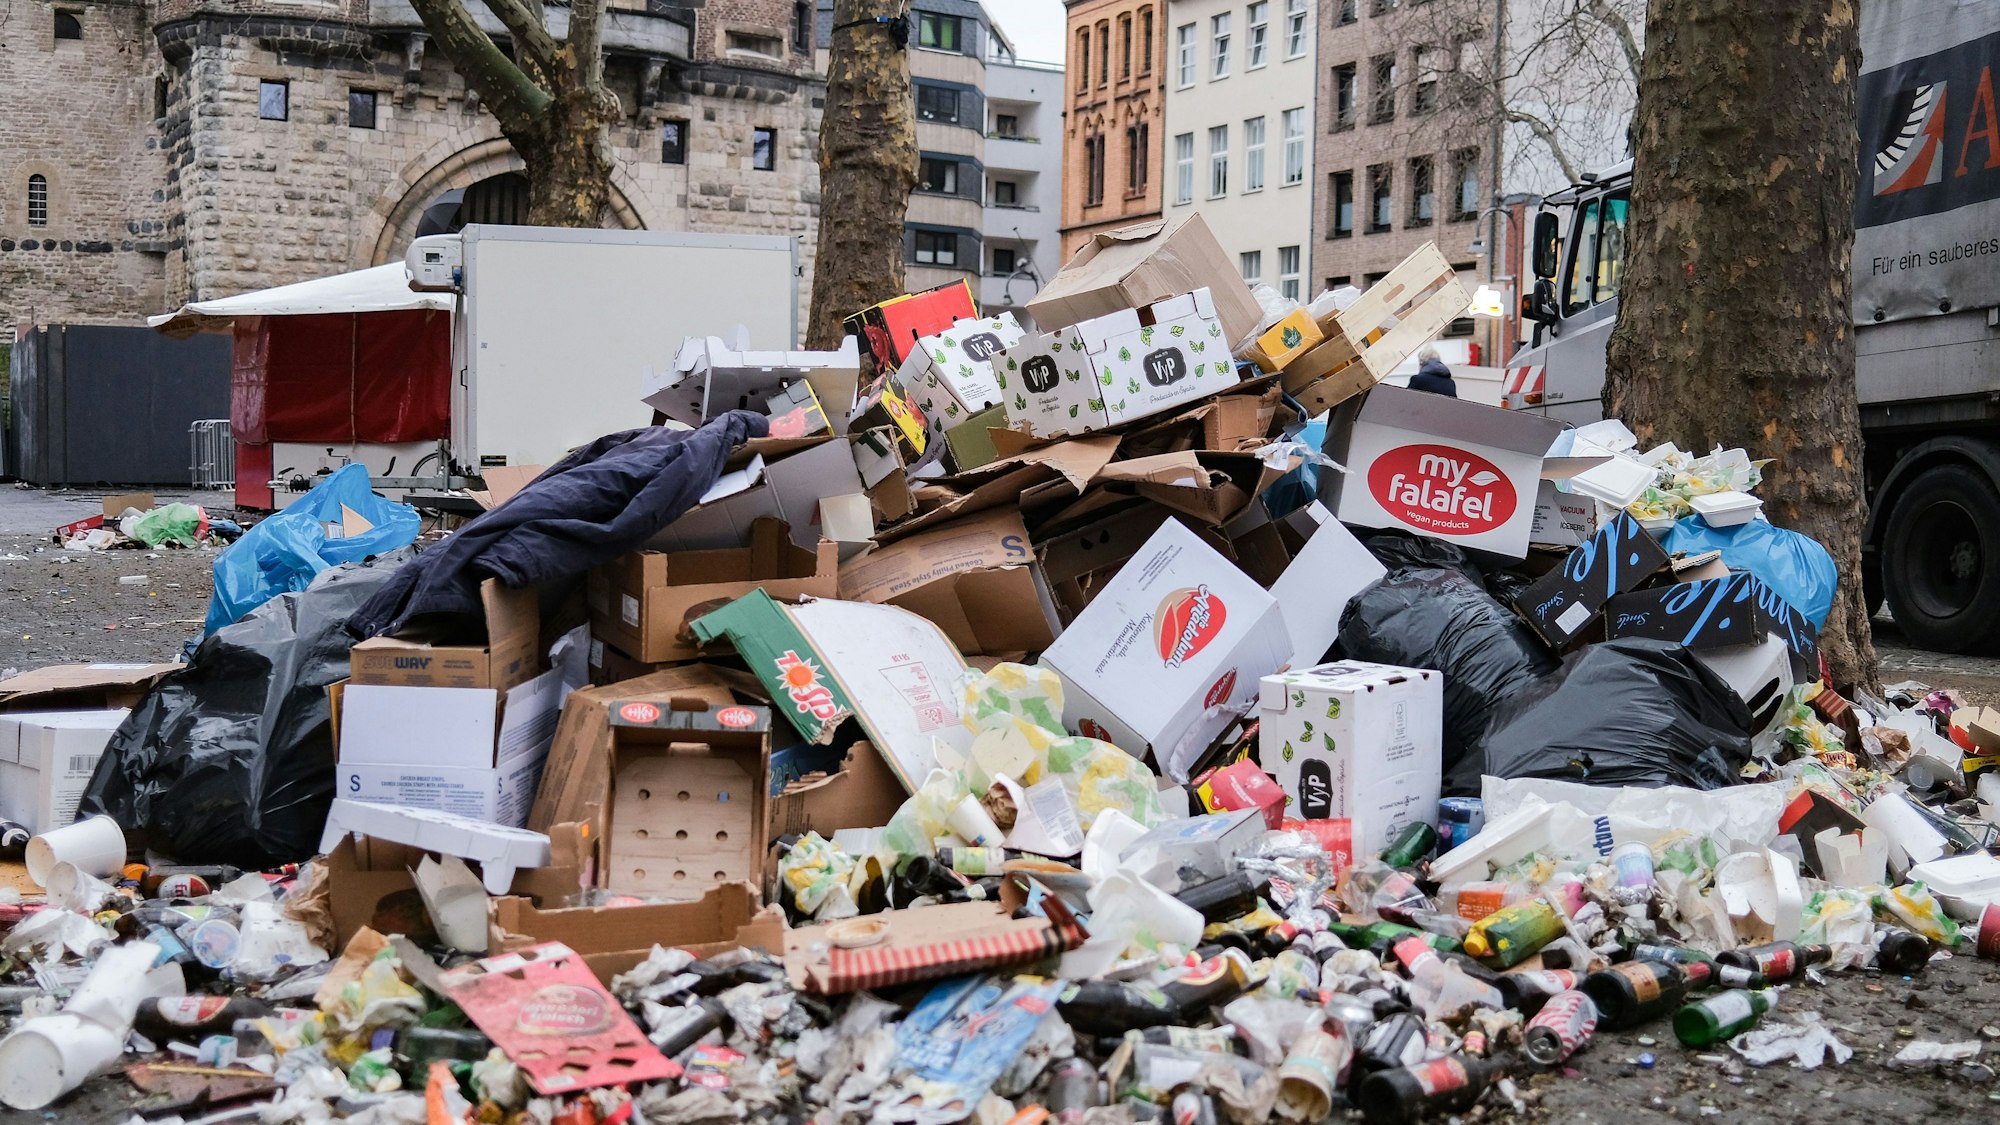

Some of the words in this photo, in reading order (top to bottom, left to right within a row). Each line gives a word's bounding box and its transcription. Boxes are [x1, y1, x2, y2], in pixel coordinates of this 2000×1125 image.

[1872, 256, 1895, 276] Für
[1899, 250, 1921, 270] ein
[1928, 238, 1999, 266] sauberes
[1028, 365, 1050, 391] VyP
[1151, 357, 1176, 384] VyP
[1418, 453, 1471, 488] my
[1388, 473, 1493, 522] falafel
[1406, 510, 1431, 524] vegan
[1431, 518, 1470, 529] products
[1560, 505, 1585, 515] VACUUM
[1560, 522, 1586, 532] ICEBERG
[1001, 535, 1026, 558] S
[932, 564, 956, 580] Philly
[954, 558, 984, 572] Cooked
[889, 577, 912, 594] Steak
[912, 571, 933, 585] Style
[1535, 590, 1564, 621] Smile
[1164, 583, 1211, 669] Anadolum
[1199, 610, 1211, 630] mis
[1616, 612, 1651, 630] Smile
[363, 655, 433, 670] SUBWAY
[349, 774, 361, 793] S
[1307, 774, 1331, 807] VyP
